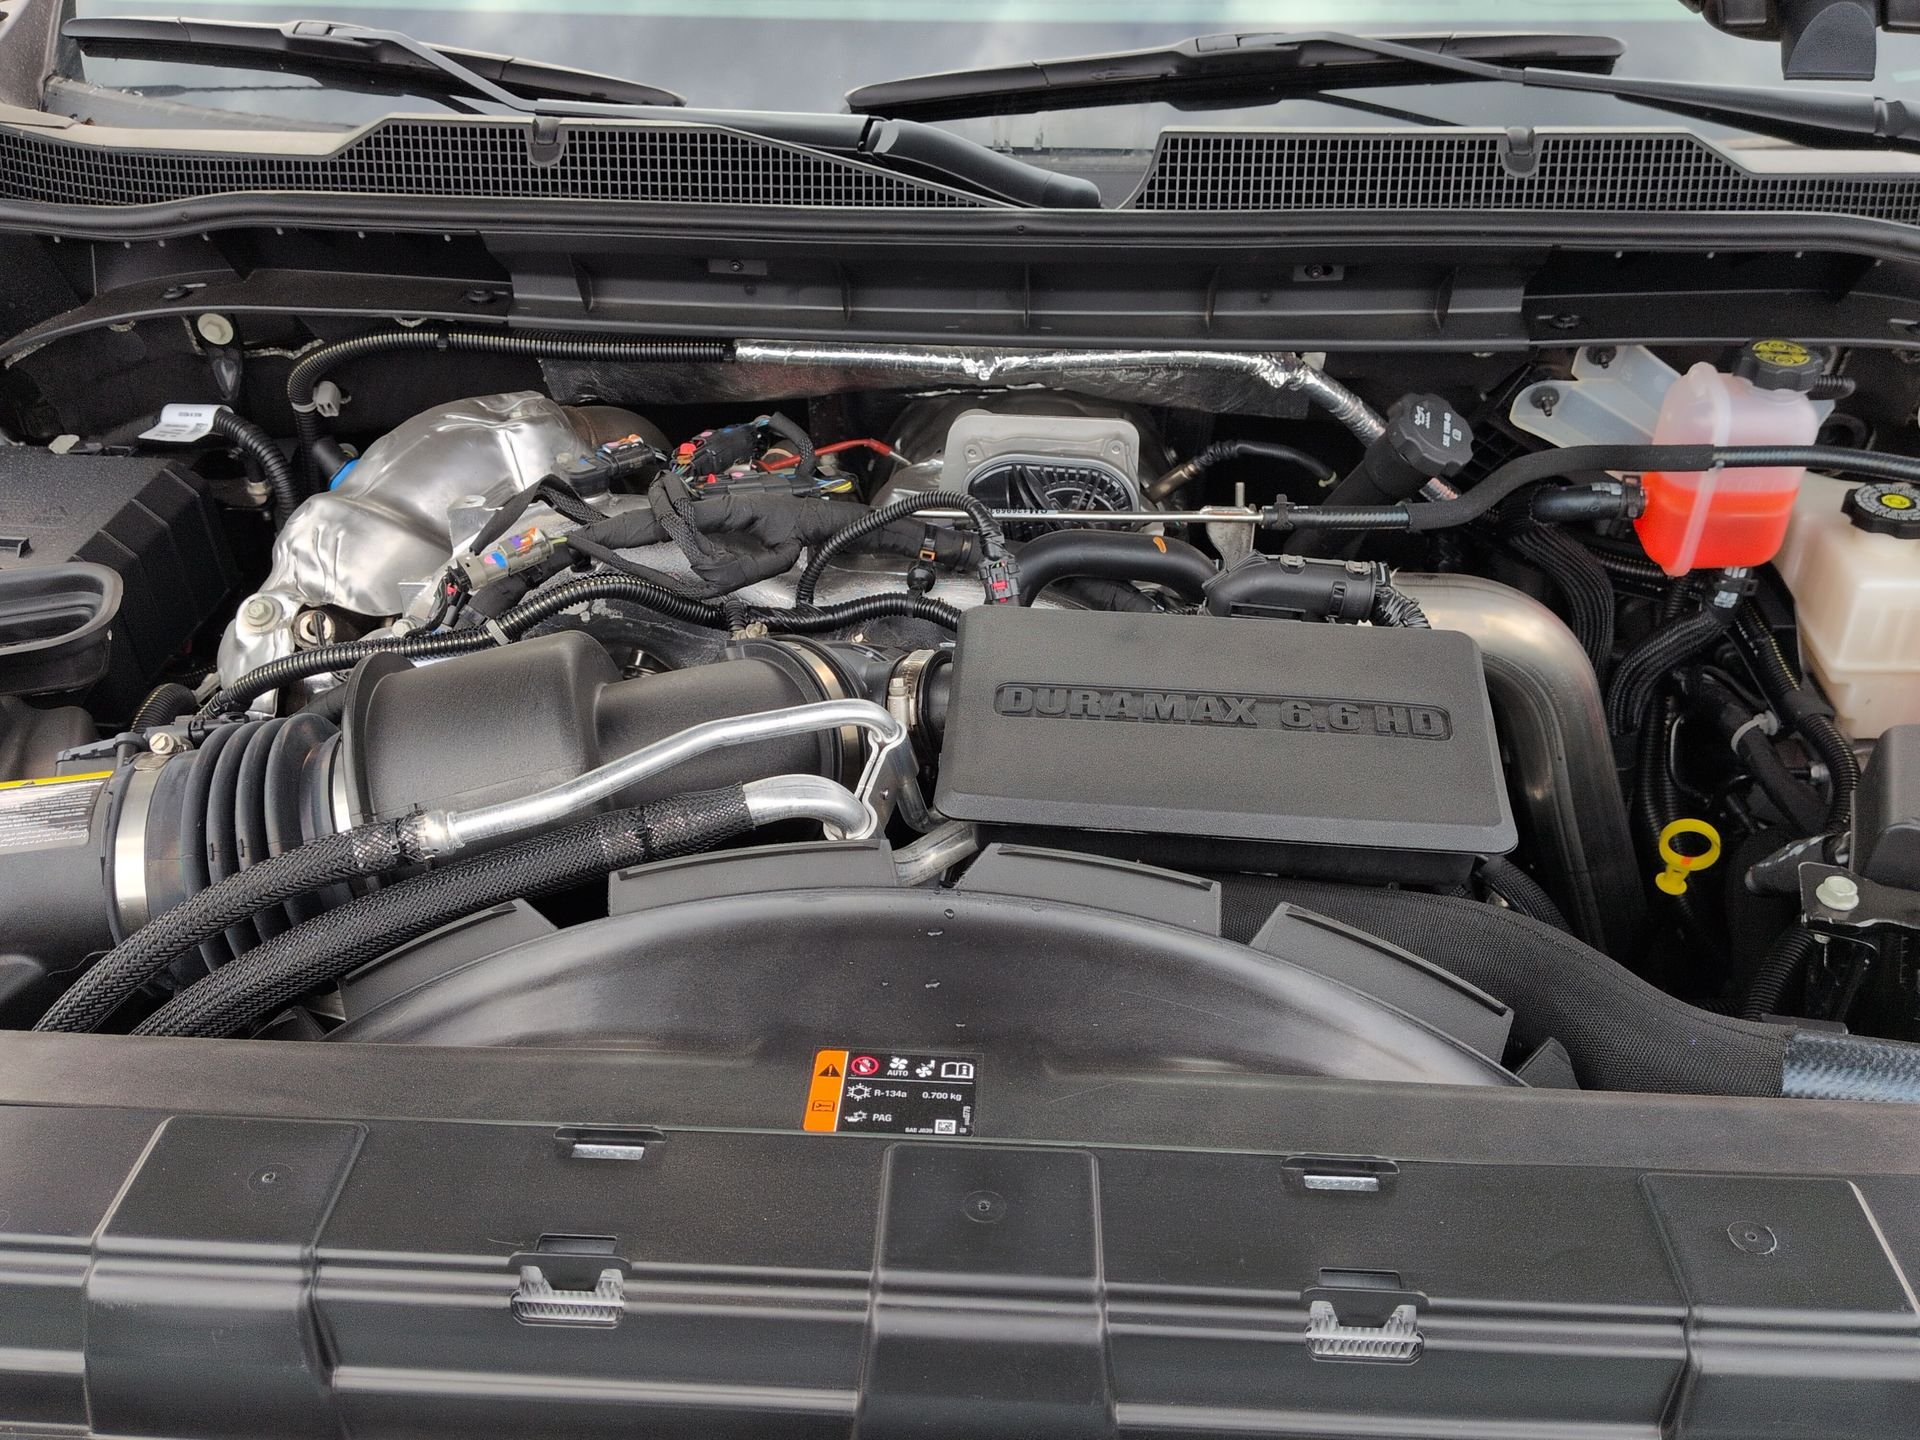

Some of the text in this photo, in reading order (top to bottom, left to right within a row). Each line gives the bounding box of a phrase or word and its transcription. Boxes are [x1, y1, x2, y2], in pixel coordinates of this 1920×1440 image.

[1001, 687, 1445, 737] DURAMAX 6.6 HD
[887, 1069, 908, 1077] AUTO
[874, 1089, 962, 1102] R-134a 0.700 kg
[872, 1113, 892, 1122] PAG
